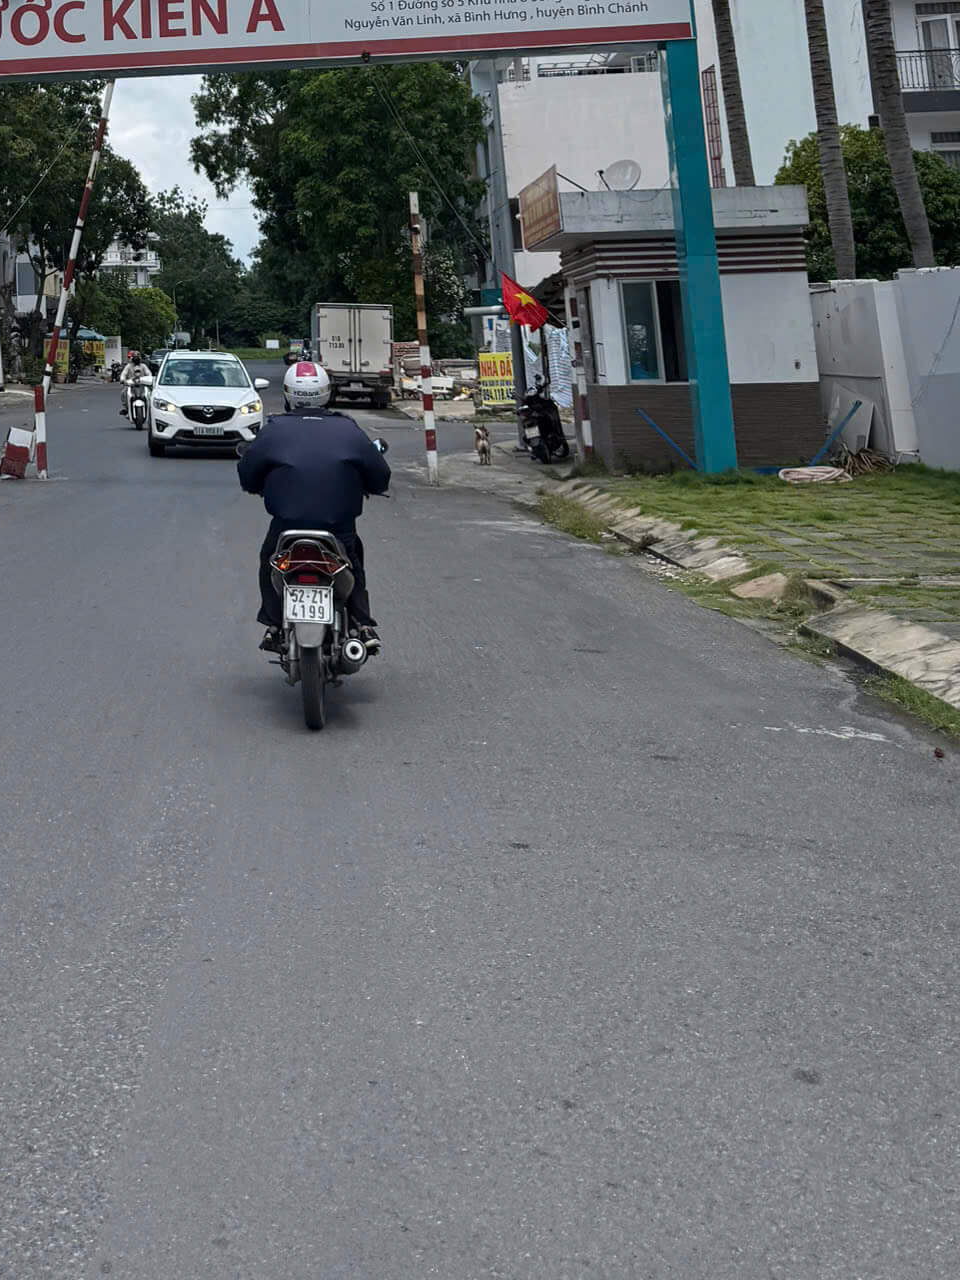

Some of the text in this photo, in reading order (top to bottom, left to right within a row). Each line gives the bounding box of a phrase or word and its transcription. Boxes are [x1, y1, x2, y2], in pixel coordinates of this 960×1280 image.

[371, 0, 386, 11] Số
[391, 16, 413, 26] Văn
[417, 14, 445, 25] Linh,
[448, 13, 461, 23] xã
[464, 11, 491, 22] Bình
[494, 10, 527, 21] Hưng
[578, 4, 605, 16] Bình
[608, 1, 649, 14] Chánh
[500, 353, 513, 376] ĐẤ
[292, 604, 325, 620] 4199
